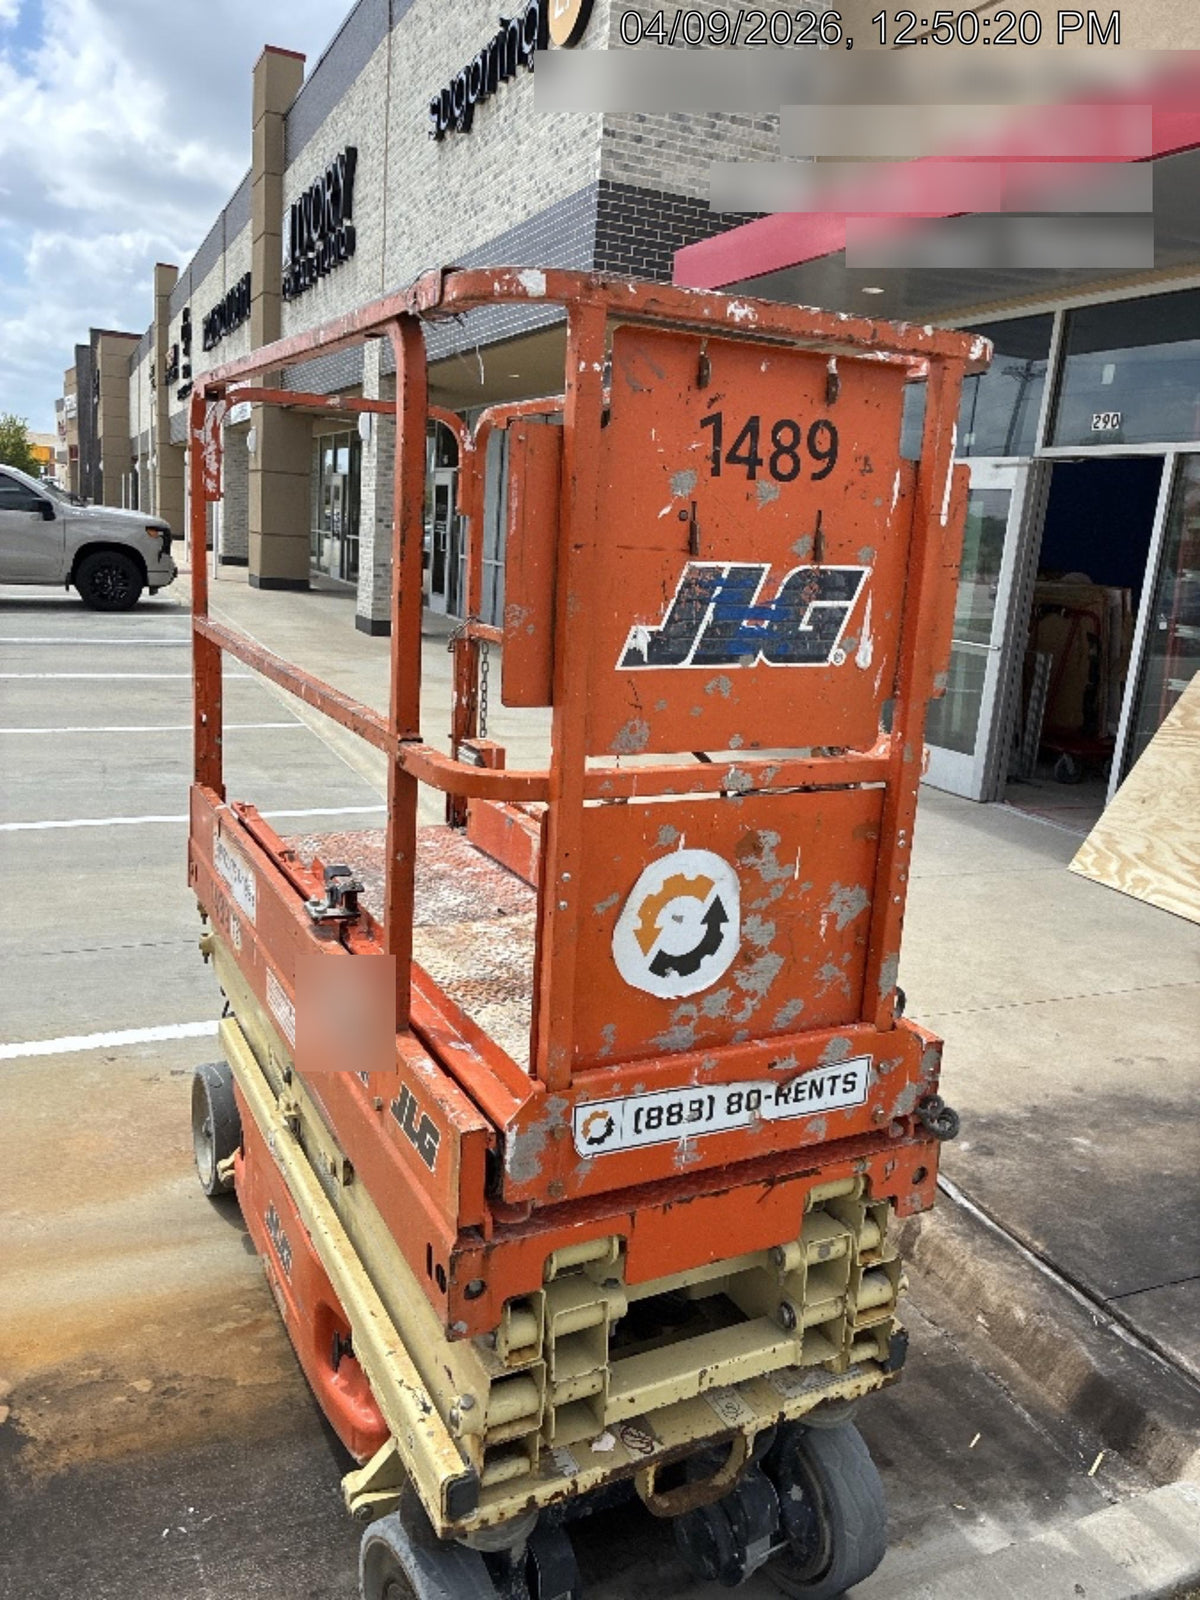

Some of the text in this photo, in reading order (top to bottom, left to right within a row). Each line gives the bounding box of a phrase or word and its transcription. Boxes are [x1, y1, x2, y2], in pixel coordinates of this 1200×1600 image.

[700, 411, 839, 482] 1489
[1093, 413, 1119, 429] 290
[614, 562, 872, 670] JLG
[390, 1081, 441, 1173] JLG
[726, 1071, 858, 1115] 80-RENTS
